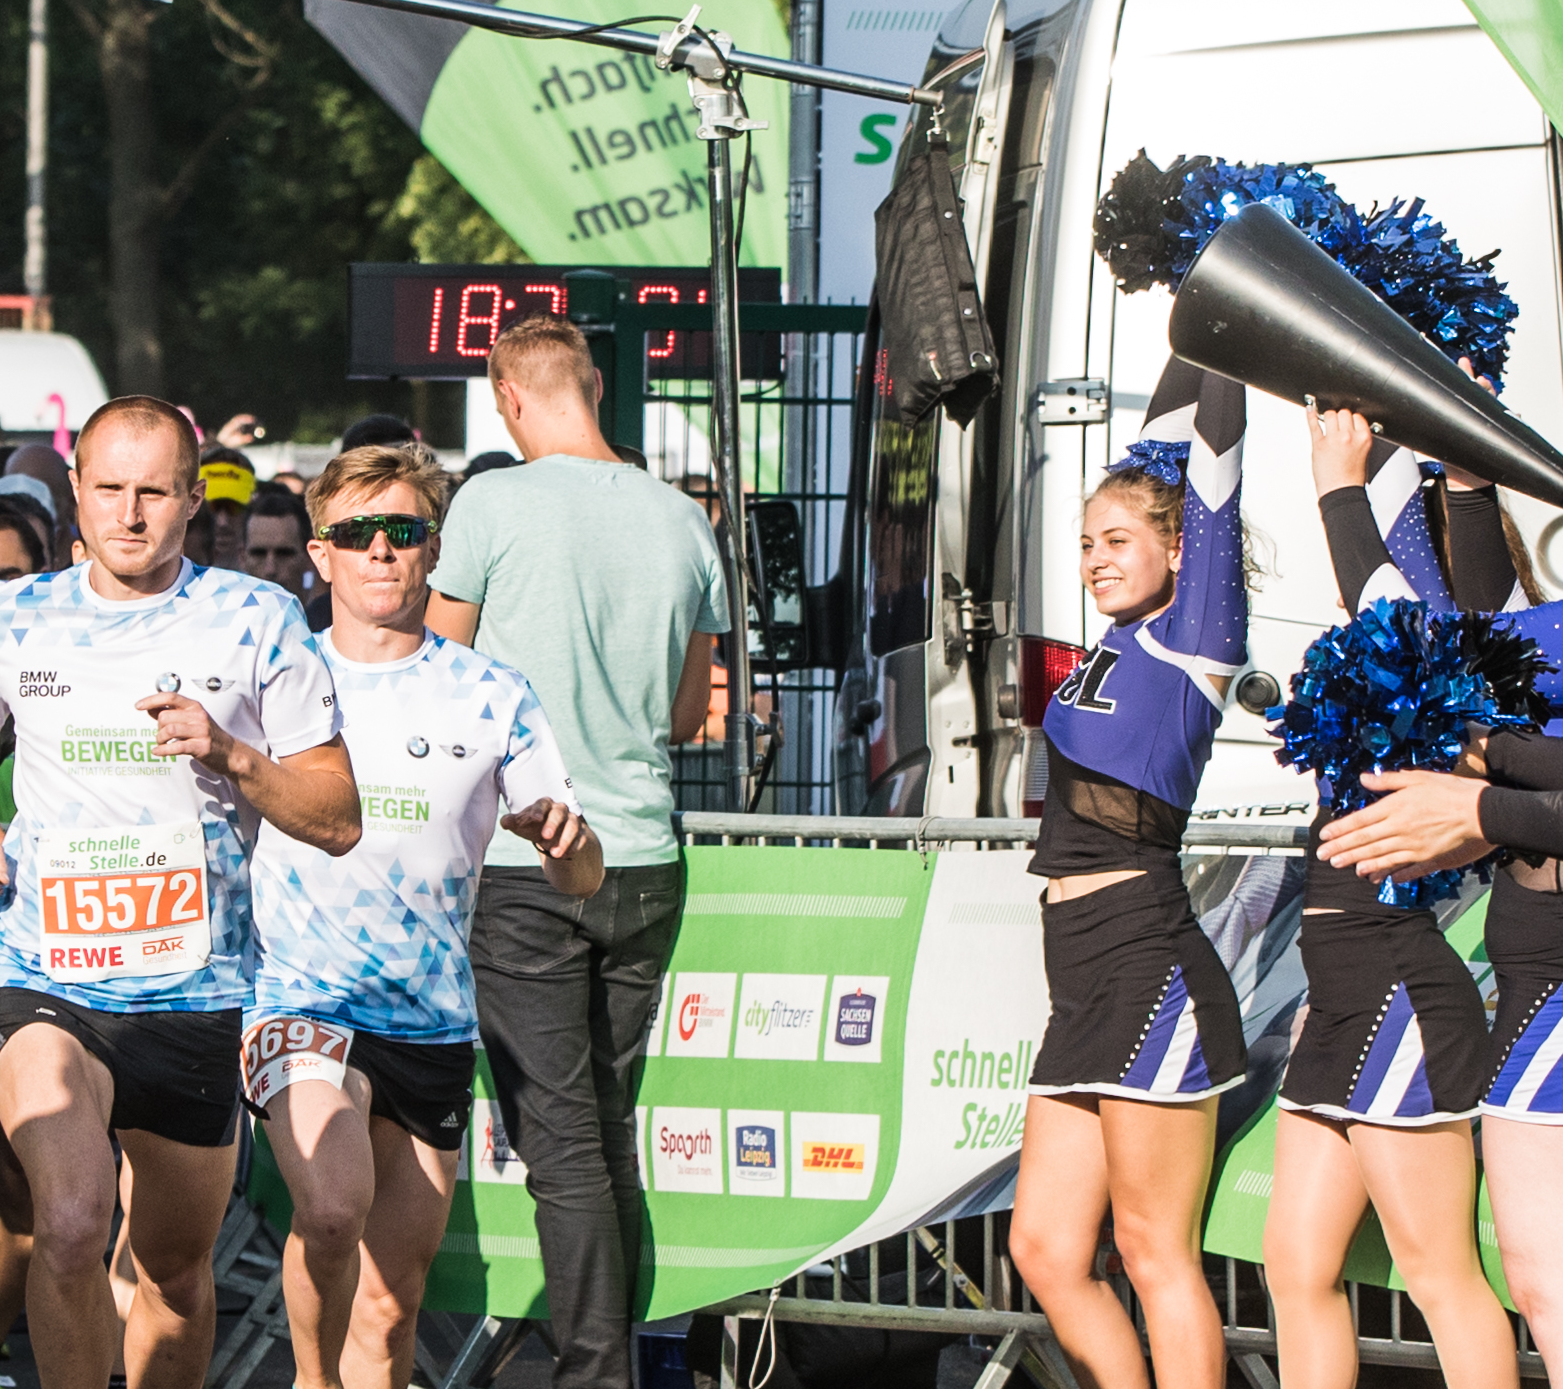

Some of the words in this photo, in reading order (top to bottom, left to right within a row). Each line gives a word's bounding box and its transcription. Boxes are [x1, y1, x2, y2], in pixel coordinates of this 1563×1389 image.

[19, 670, 58, 684] BMW
[19, 684, 72, 698] GROUP
[65, 724, 138, 737] Gemeinsam
[68, 766, 113, 777] INITIATIVE
[115, 766, 172, 777] GESUNDHEIT
[394, 784, 427, 798] mehr
[68, 835, 141, 854] schnelle
[89, 851, 167, 871] Stelle.de
[45, 871, 199, 932] 15572
[141, 935, 185, 956] DAK
[50, 945, 124, 969] REWE
[744, 999, 805, 1036] cityflitzer
[840, 1007, 872, 1023] SACHSEN
[839, 1023, 868, 1040] QUELLE
[741, 1129, 768, 1147] Radio
[809, 1146, 857, 1168] DHL
